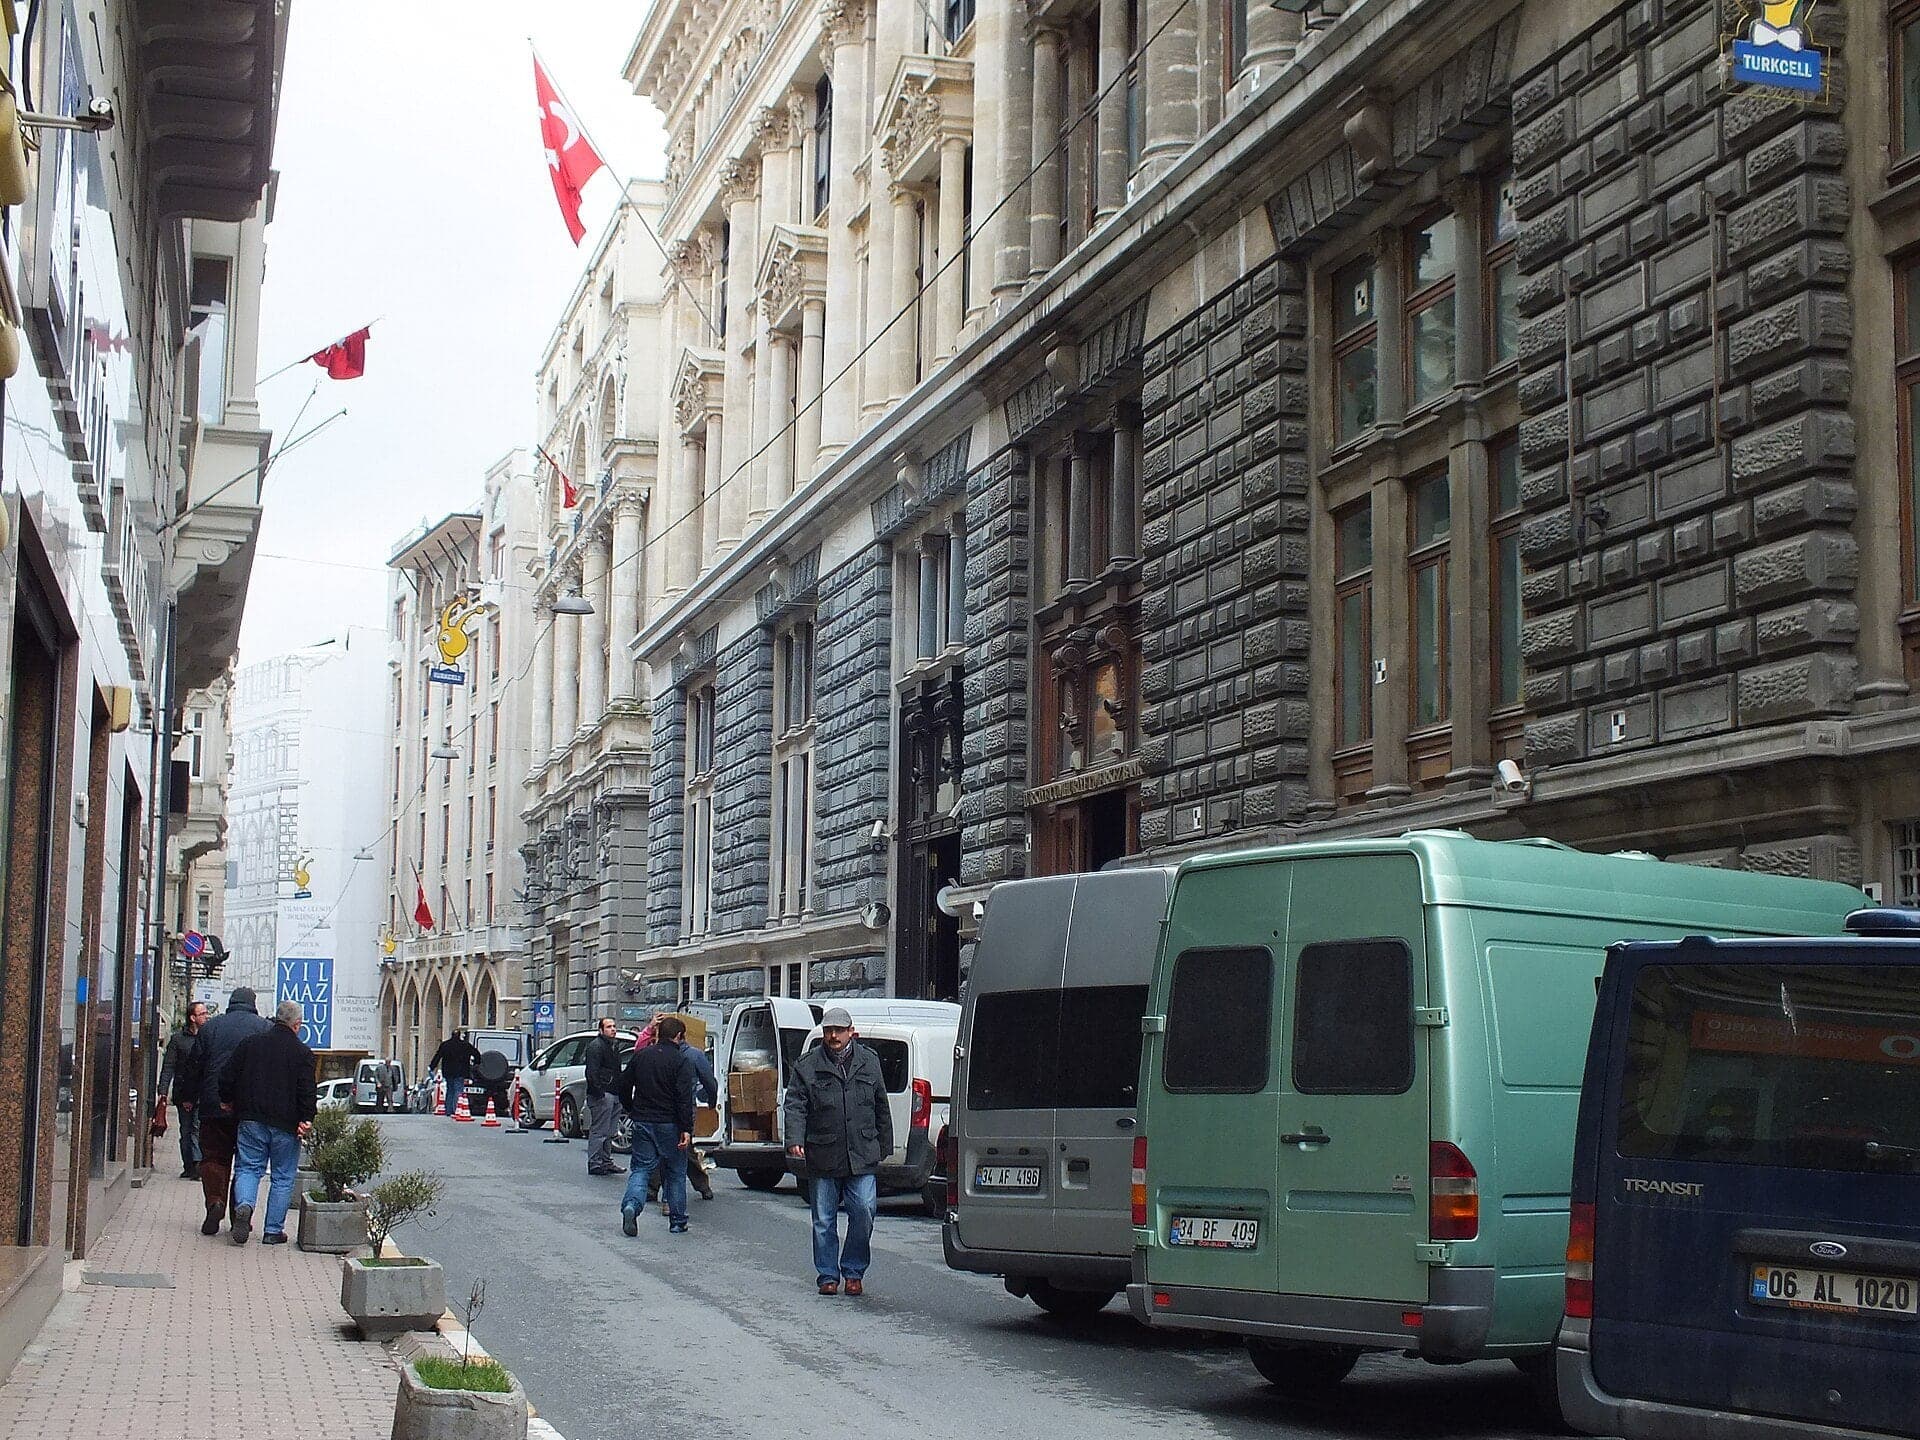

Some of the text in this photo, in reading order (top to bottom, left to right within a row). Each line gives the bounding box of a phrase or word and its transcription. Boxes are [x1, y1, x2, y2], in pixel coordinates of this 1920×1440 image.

[1743, 54, 1812, 78] TURKCELL
[281, 962, 328, 981] YIL
[280, 983, 328, 1003] MAZ
[301, 1004, 328, 1024] LU
[300, 1024, 327, 1044] OY
[983, 1169, 1038, 1185] 34 AF 4196
[1623, 1177, 1704, 1197] TRANSIT
[1180, 1219, 1256, 1241] 34 BF 409
[1816, 1245, 1838, 1255] Ford
[1755, 1283, 1767, 1292] TR
[1769, 1270, 1910, 1310] 06 AL 1020
